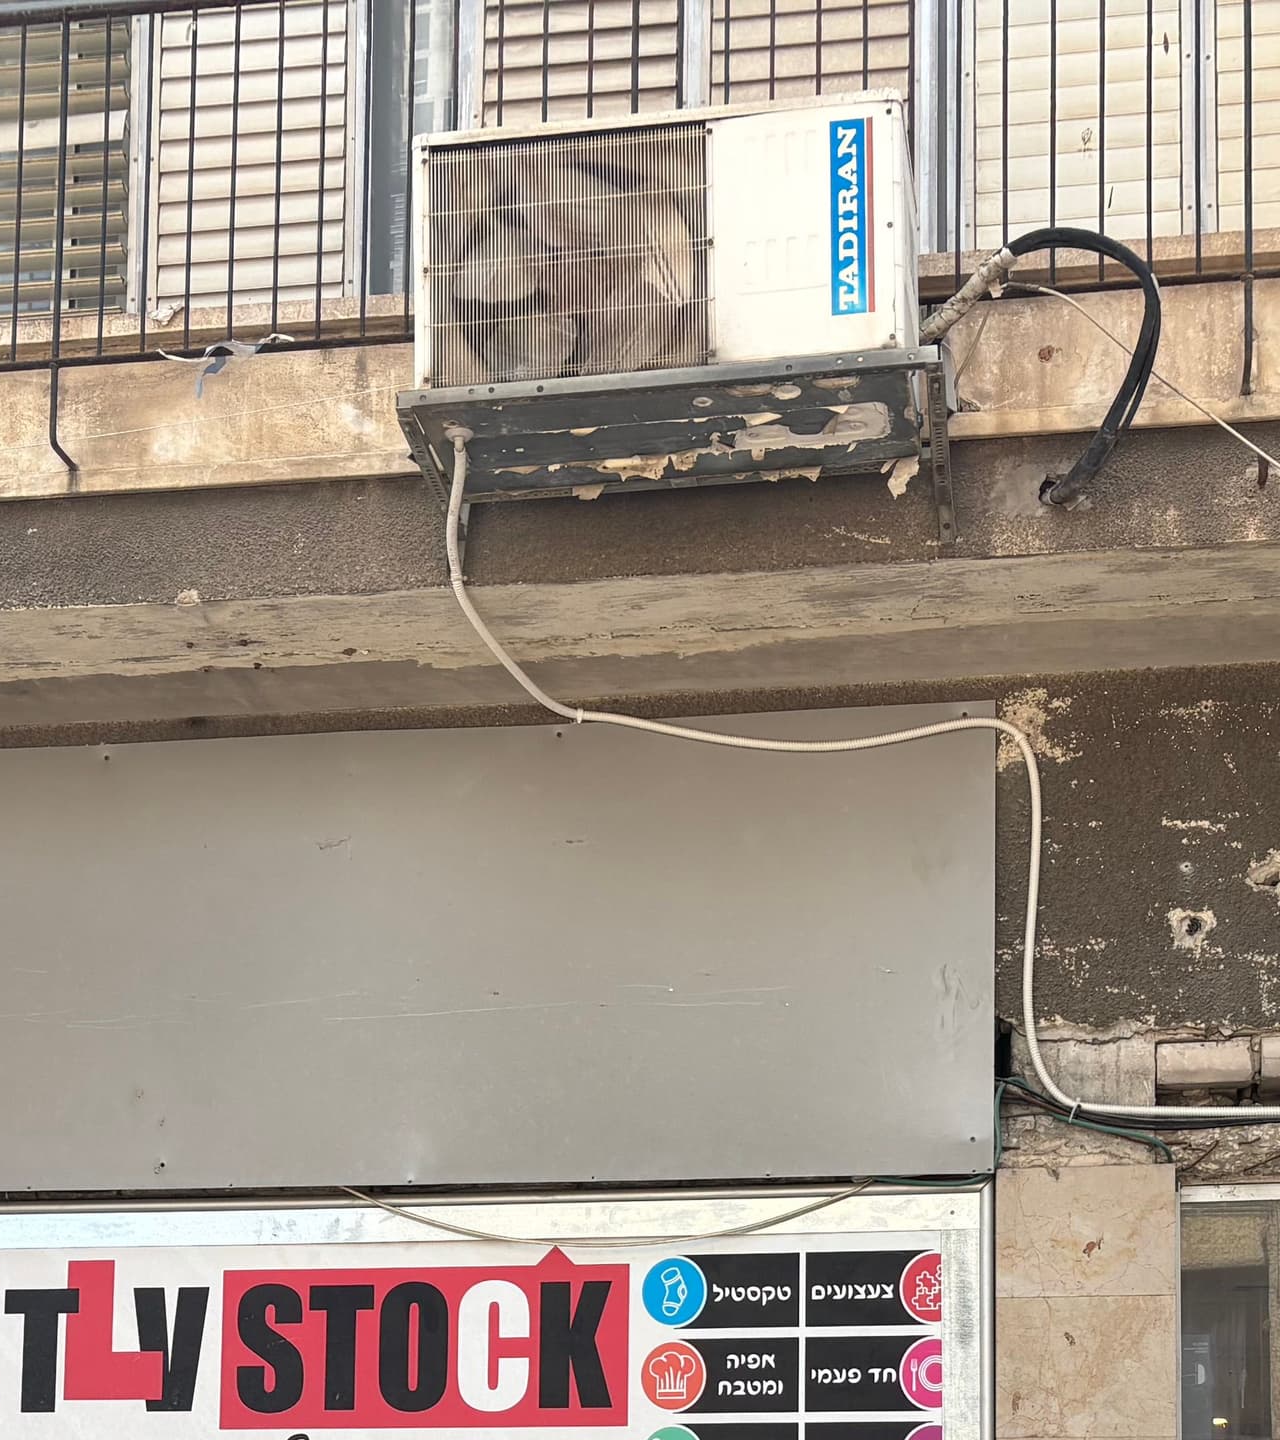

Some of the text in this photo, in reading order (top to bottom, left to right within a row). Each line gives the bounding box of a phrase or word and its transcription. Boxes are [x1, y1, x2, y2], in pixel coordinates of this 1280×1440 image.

[837, 126, 860, 311] TADIRAN
[713, 1279, 792, 1303] טקסטיל
[811, 1281, 896, 1302] צעצועים
[4, 1260, 613, 1413] TLV STOCK
[726, 1350, 776, 1369] אפיה
[717, 1379, 784, 1397] ומטבח
[811, 1365, 898, 1389] חד פעמי
